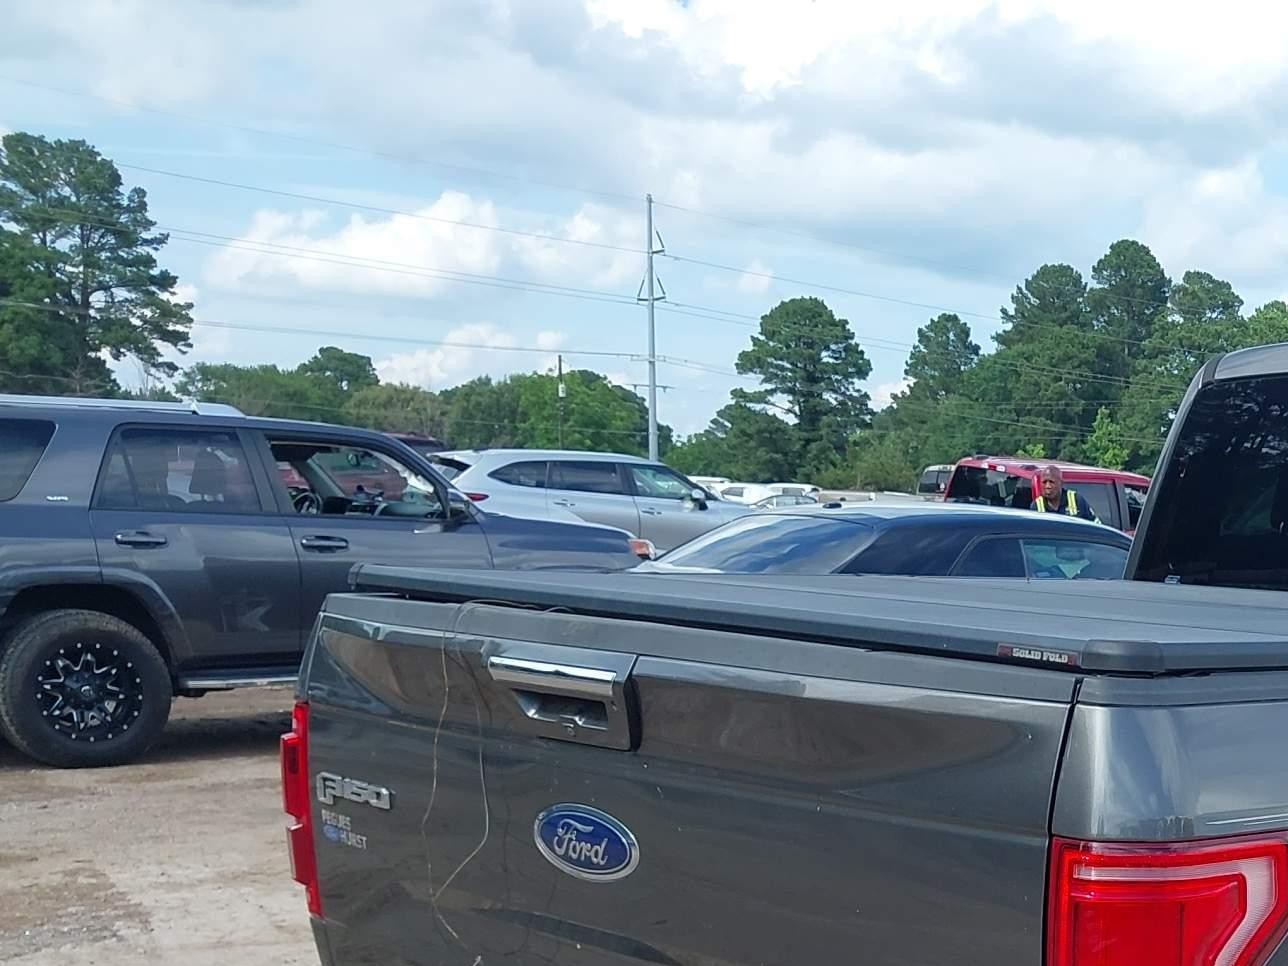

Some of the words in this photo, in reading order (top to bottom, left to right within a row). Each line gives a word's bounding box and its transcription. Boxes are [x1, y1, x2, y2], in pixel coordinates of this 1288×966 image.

[1012, 647, 1042, 660] SOLID
[1042, 651, 1069, 663] FOLD
[553, 818, 609, 866] Ford
